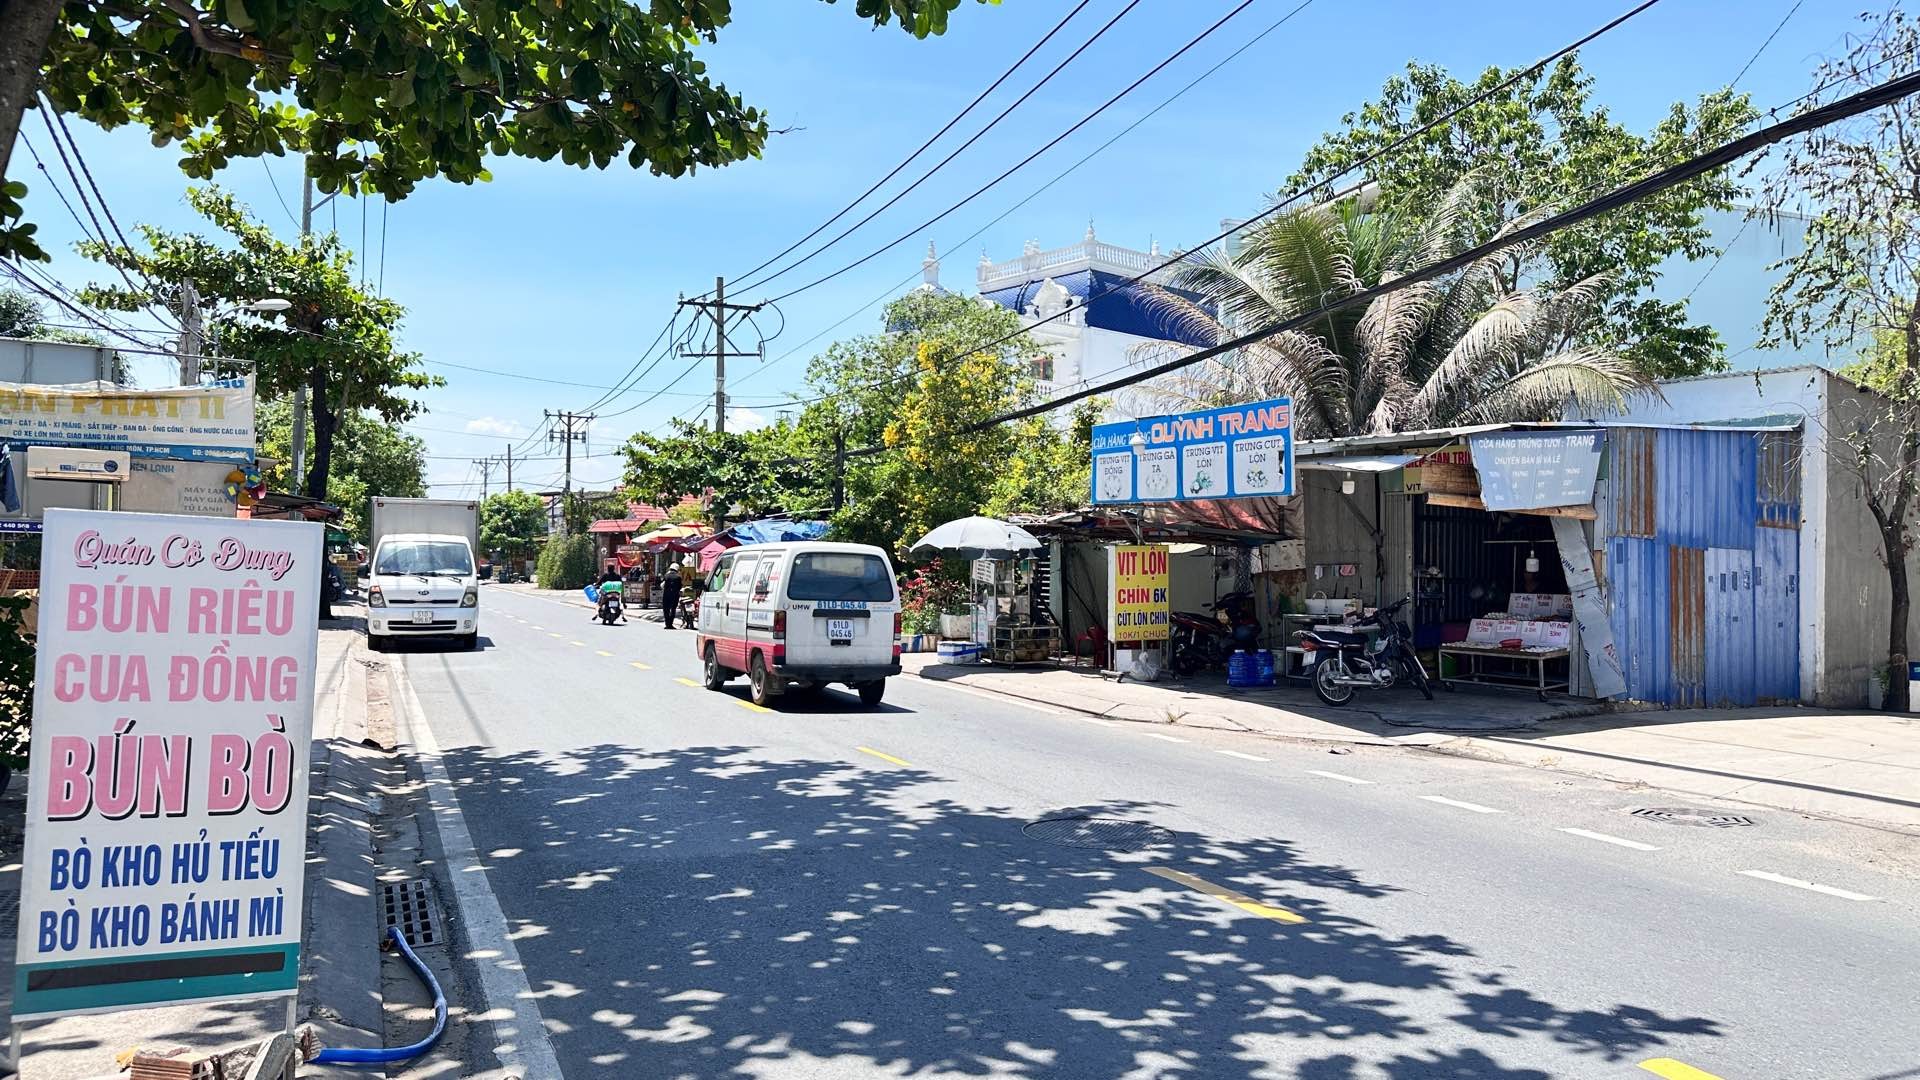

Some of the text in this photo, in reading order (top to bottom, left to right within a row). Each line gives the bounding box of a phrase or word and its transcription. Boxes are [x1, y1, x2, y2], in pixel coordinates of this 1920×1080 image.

[1151, 405, 1290, 444] QUỲNH TRANG
[1495, 437, 1516, 448] HÀNG
[1517, 437, 1543, 448] TRỨNG
[1565, 434, 1595, 446] TRANG
[74, 530, 155, 569] Quán
[161, 534, 204, 568] Cô
[1117, 546, 1167, 581] VỊT LỘN
[66, 575, 295, 635] BÚN RIÊU
[817, 600, 867, 609] 61LD-045.46
[1117, 585, 1167, 604] CHÍN 6K
[833, 620, 848, 629] 61LD
[1117, 608, 1168, 628] CÚT LỘN CHÍN
[54, 639, 298, 702] CUA ĐỒNG
[46, 714, 294, 822] BÚN BÒ
[50, 827, 280, 891] BÒ KHO HỦ TIẾU
[38, 887, 284, 953] BÒ KHO BÁNH MÌ
